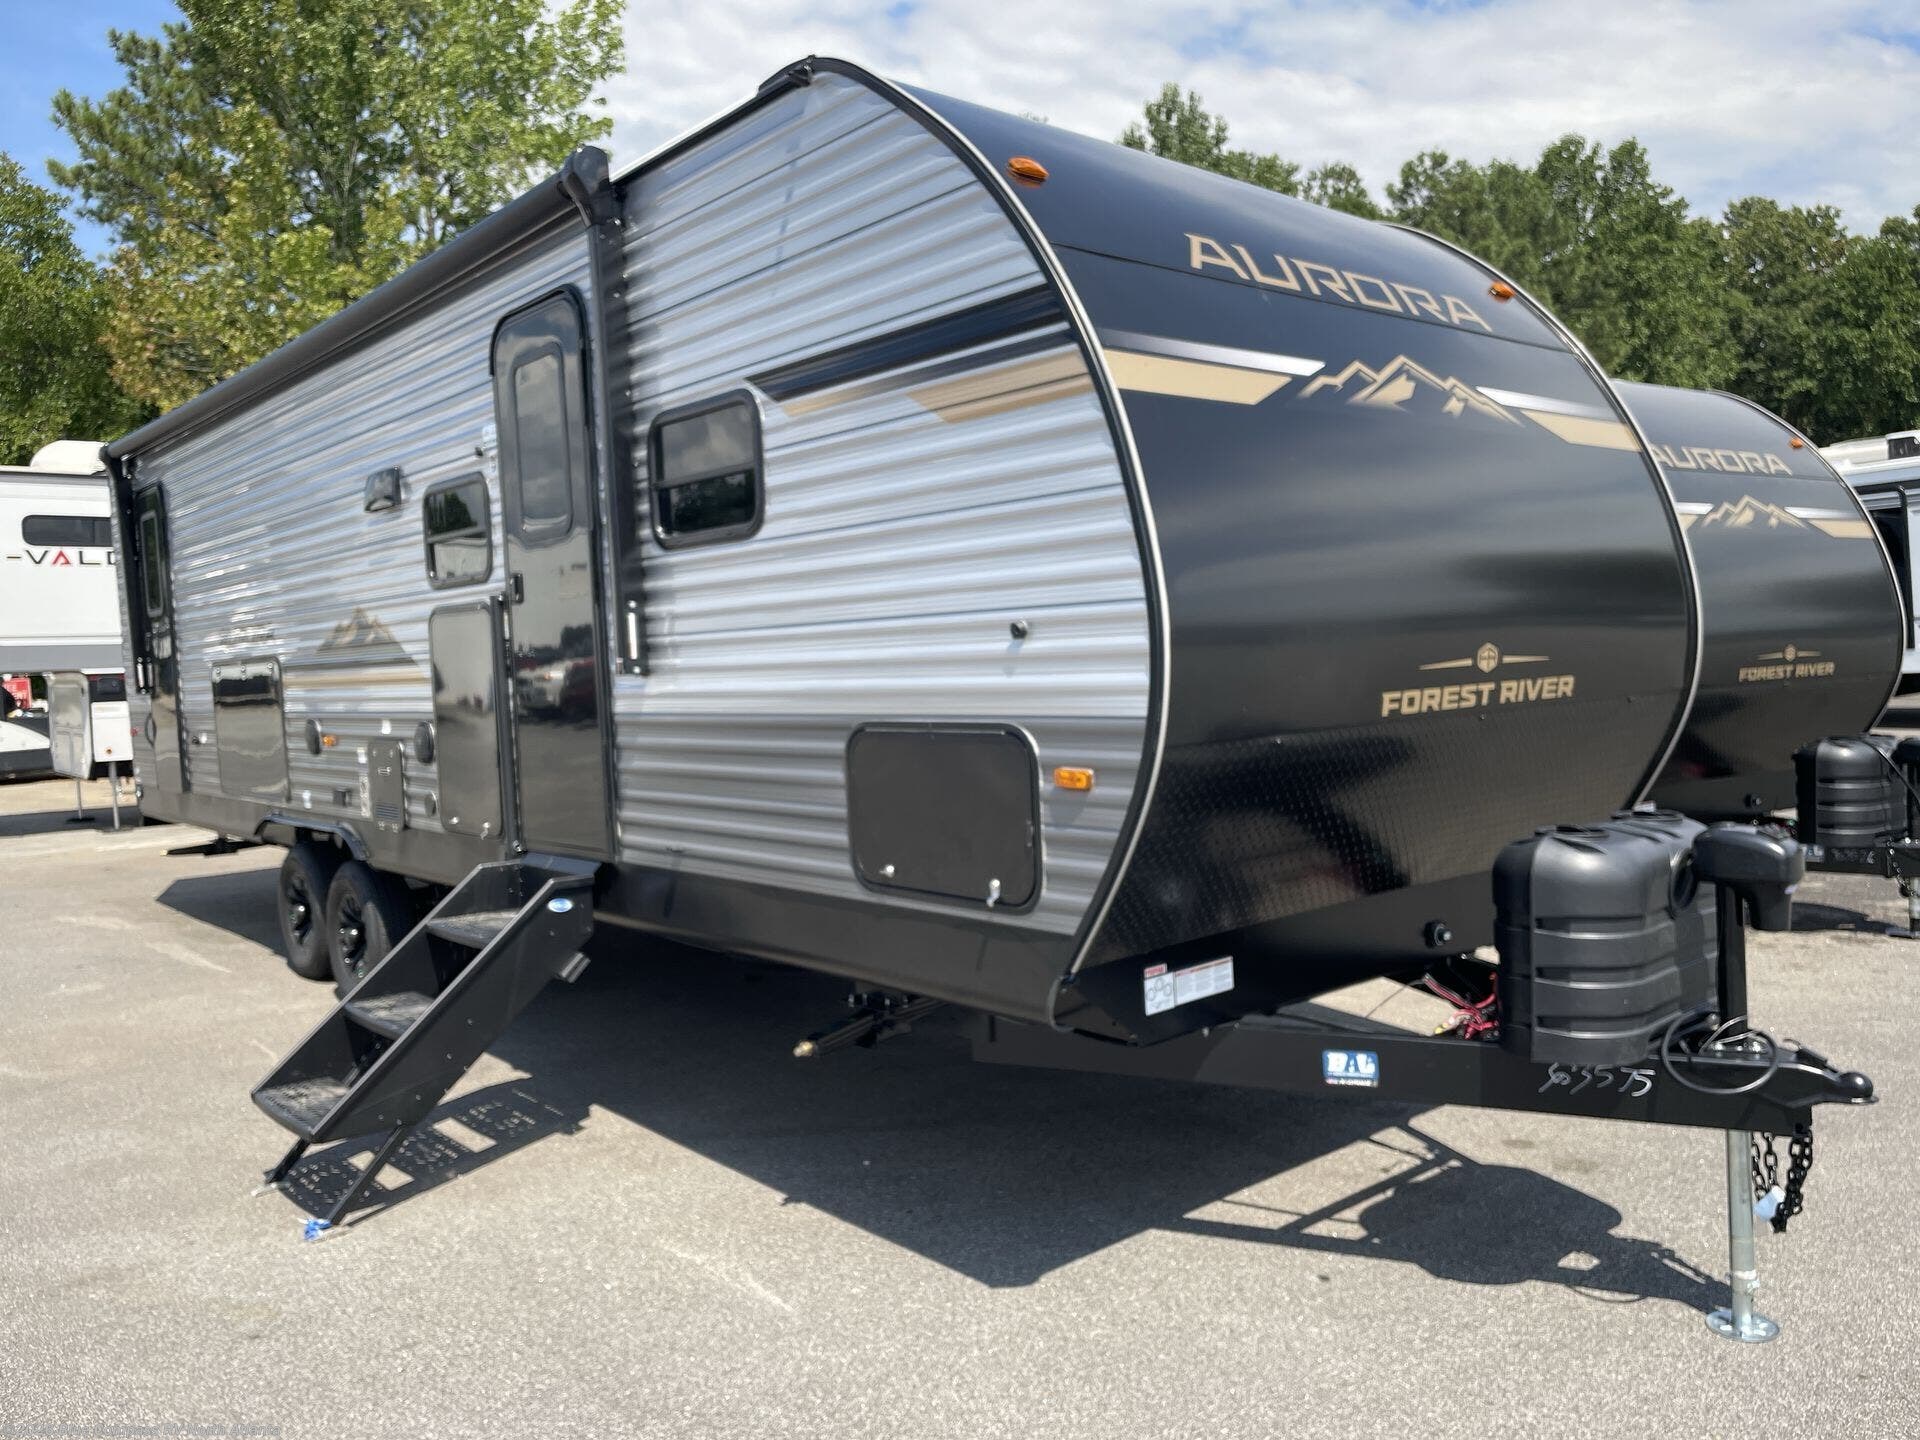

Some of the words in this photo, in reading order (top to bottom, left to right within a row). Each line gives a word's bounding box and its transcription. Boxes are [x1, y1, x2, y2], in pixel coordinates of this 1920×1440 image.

[1184, 233, 1493, 332] AURORA
[1739, 664, 1794, 682] FOREST
[1795, 661, 1836, 678] RIVER
[1381, 681, 1495, 717] FOREST
[1500, 674, 1575, 704] RIVER
